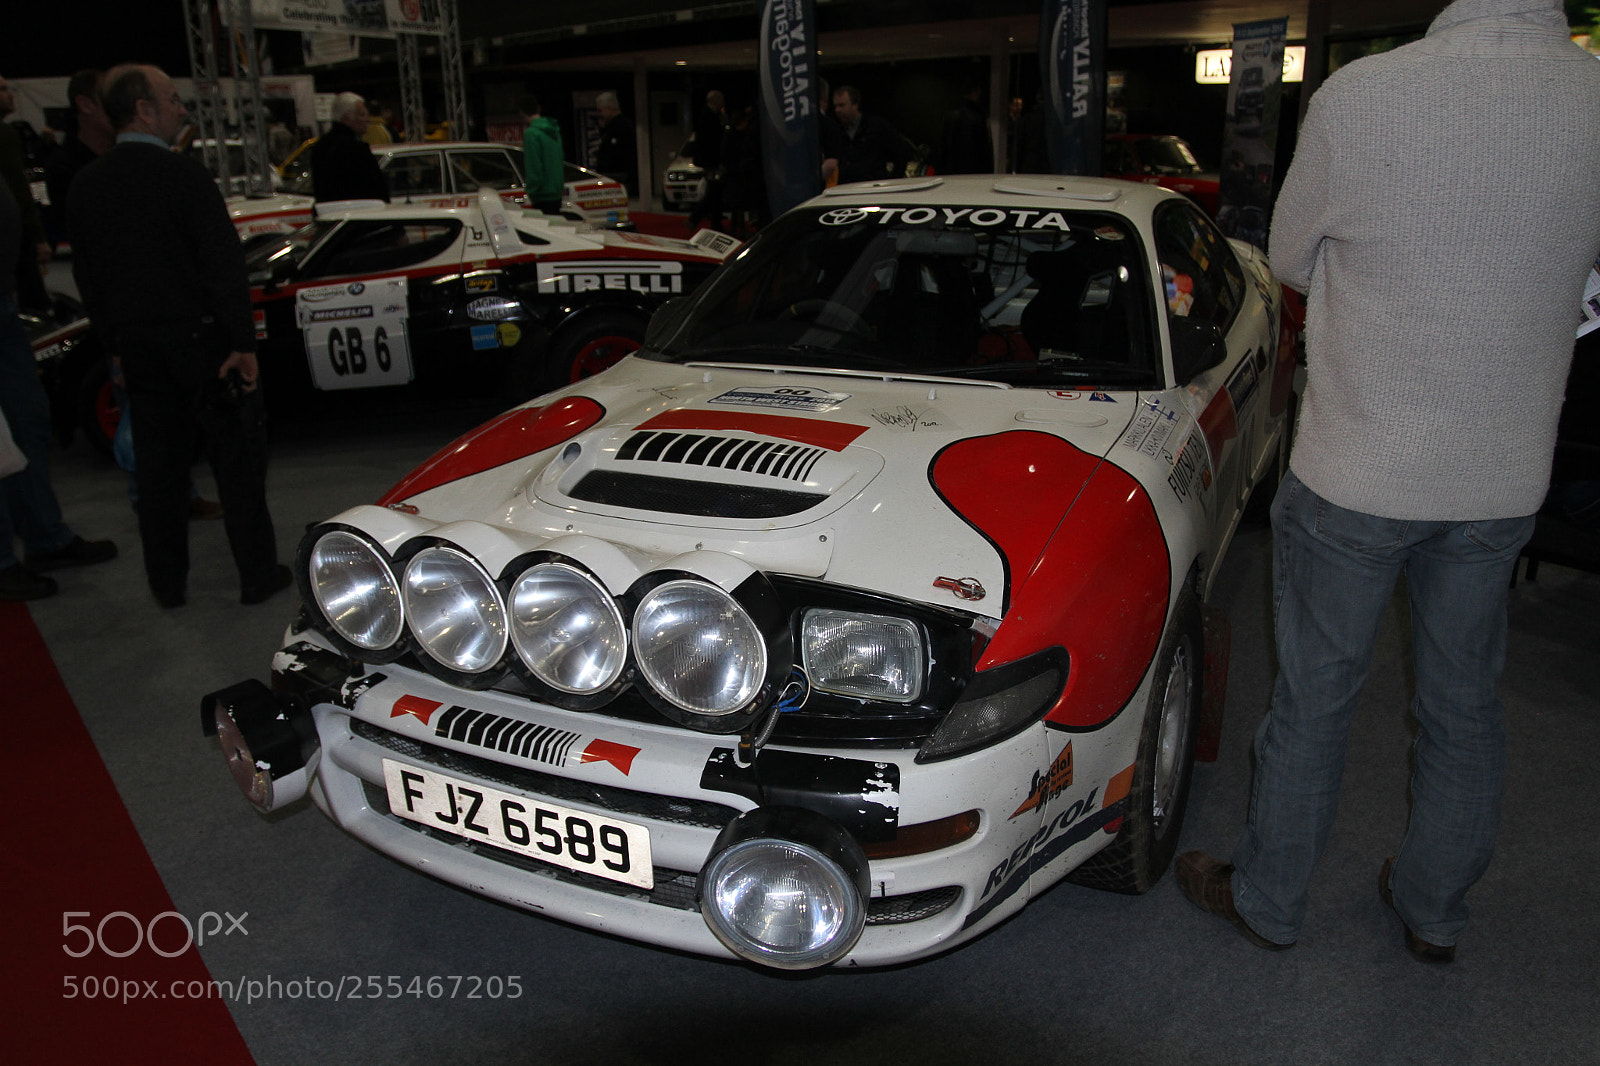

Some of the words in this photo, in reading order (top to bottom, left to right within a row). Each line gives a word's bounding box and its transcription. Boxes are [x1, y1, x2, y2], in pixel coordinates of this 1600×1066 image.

[877, 207, 1071, 231] TOYOTA
[536, 260, 683, 295] PIRELLI
[312, 308, 371, 321] MICHELIN
[328, 327, 367, 376] GB
[374, 326, 391, 373] 6
[774, 388, 811, 396] 00
[499, 799, 630, 874] 6589
[980, 786, 1099, 901] REPSOL
